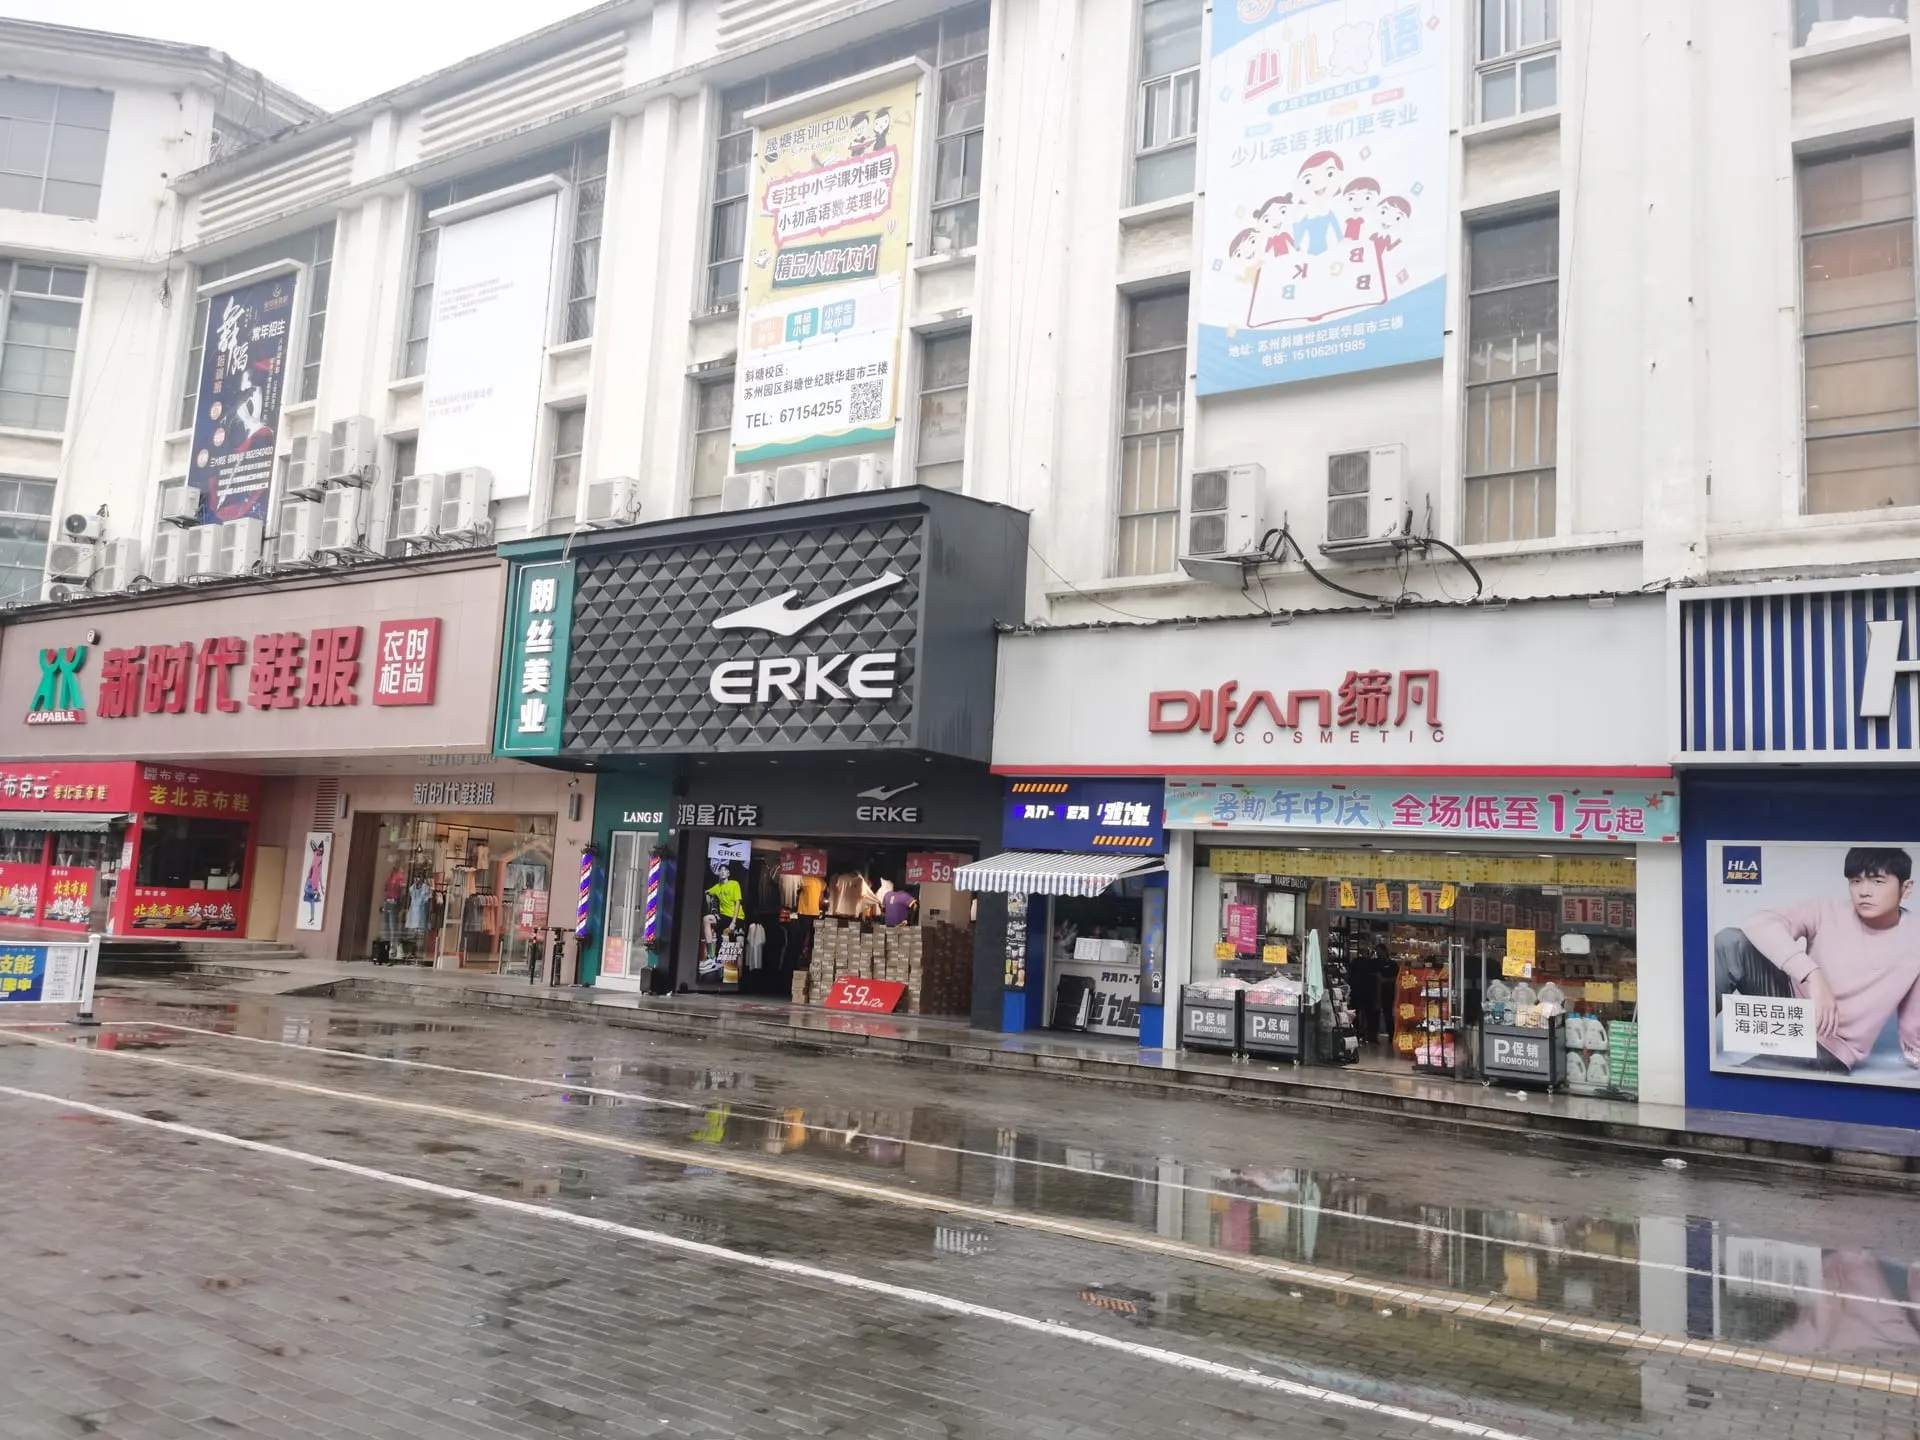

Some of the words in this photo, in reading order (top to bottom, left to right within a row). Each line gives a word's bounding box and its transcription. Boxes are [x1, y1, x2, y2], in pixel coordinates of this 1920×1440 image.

[1243, 5, 1422, 100] 少儿语
[764, 114, 849, 153] 晟塘培训中心
[1230, 130, 1309, 168] 少儿英语
[1313, 102, 1418, 147] 我们更专业
[771, 156, 893, 206] 专注中小学课外辅导
[778, 186, 887, 232] 小初高语数英理化
[775, 244, 878, 281] 精品小班1对1
[1291, 338, 1366, 362] 15106201985
[744, 360, 889, 401] 苏州园区斜塘世纪联华超市三楼
[745, 413, 773, 429] TEL:
[779, 399, 843, 424] 67154255
[518, 577, 559, 734] 朗丝美业
[97, 625, 364, 719] 新时代鞋服
[709, 652, 897, 704] ERKE
[1337, 668, 1443, 728] 缔凡
[27, 711, 76, 723] CAPABLE
[1234, 729, 1445, 744] COSMETIC
[53, 784, 108, 801] 老北京布鞋
[149, 784, 249, 812] 老北京布鞋
[413, 781, 495, 805] 新时代鞋服
[624, 810, 653, 824] LANG
[677, 803, 759, 827] 鸿星尔克
[856, 806, 918, 823] ERKE
[1213, 789, 1371, 827] 暑期年中庆
[1390, 791, 1647, 836] 全场低至1元起
[718, 849, 743, 858] ERKE
[1727, 860, 1758, 871] HLA
[187, 902, 234, 920] 欢迎您
[1735, 1002, 1804, 1020] 国民品牌
[1735, 1019, 1804, 1037] 海澜之家
